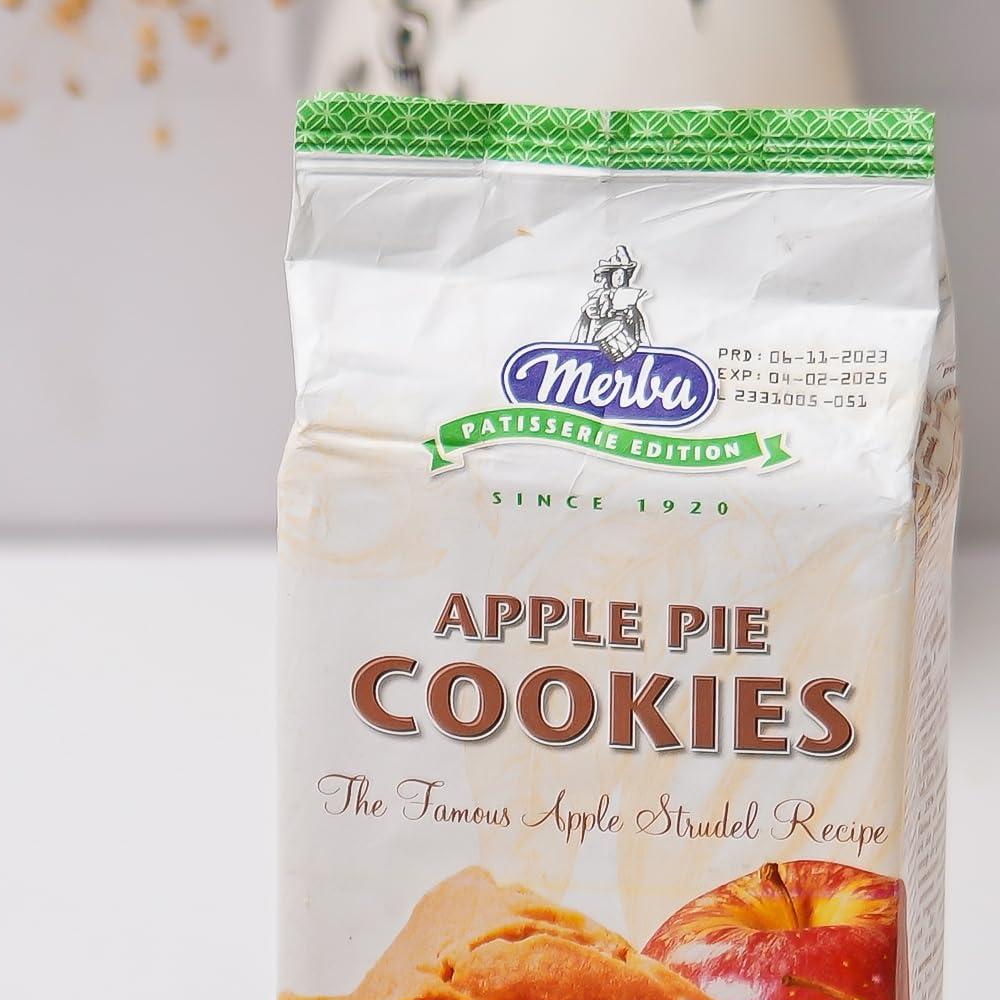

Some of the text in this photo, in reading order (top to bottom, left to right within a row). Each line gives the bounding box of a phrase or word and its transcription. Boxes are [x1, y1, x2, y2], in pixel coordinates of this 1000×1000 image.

[516, 353, 698, 410] Merba
[717, 367, 887, 386] EXP: 04-02-2025
[718, 347, 888, 364] PRD: 06-11-2023
[461, 415, 741, 462] PATISSERIE EDITION
[492, 491, 729, 517] SINCE 1920
[433, 592, 769, 652] APPLE PIE
[351, 655, 855, 757] COOKIES
[317, 773, 889, 858] The Famous Apple Strudel Recipe
